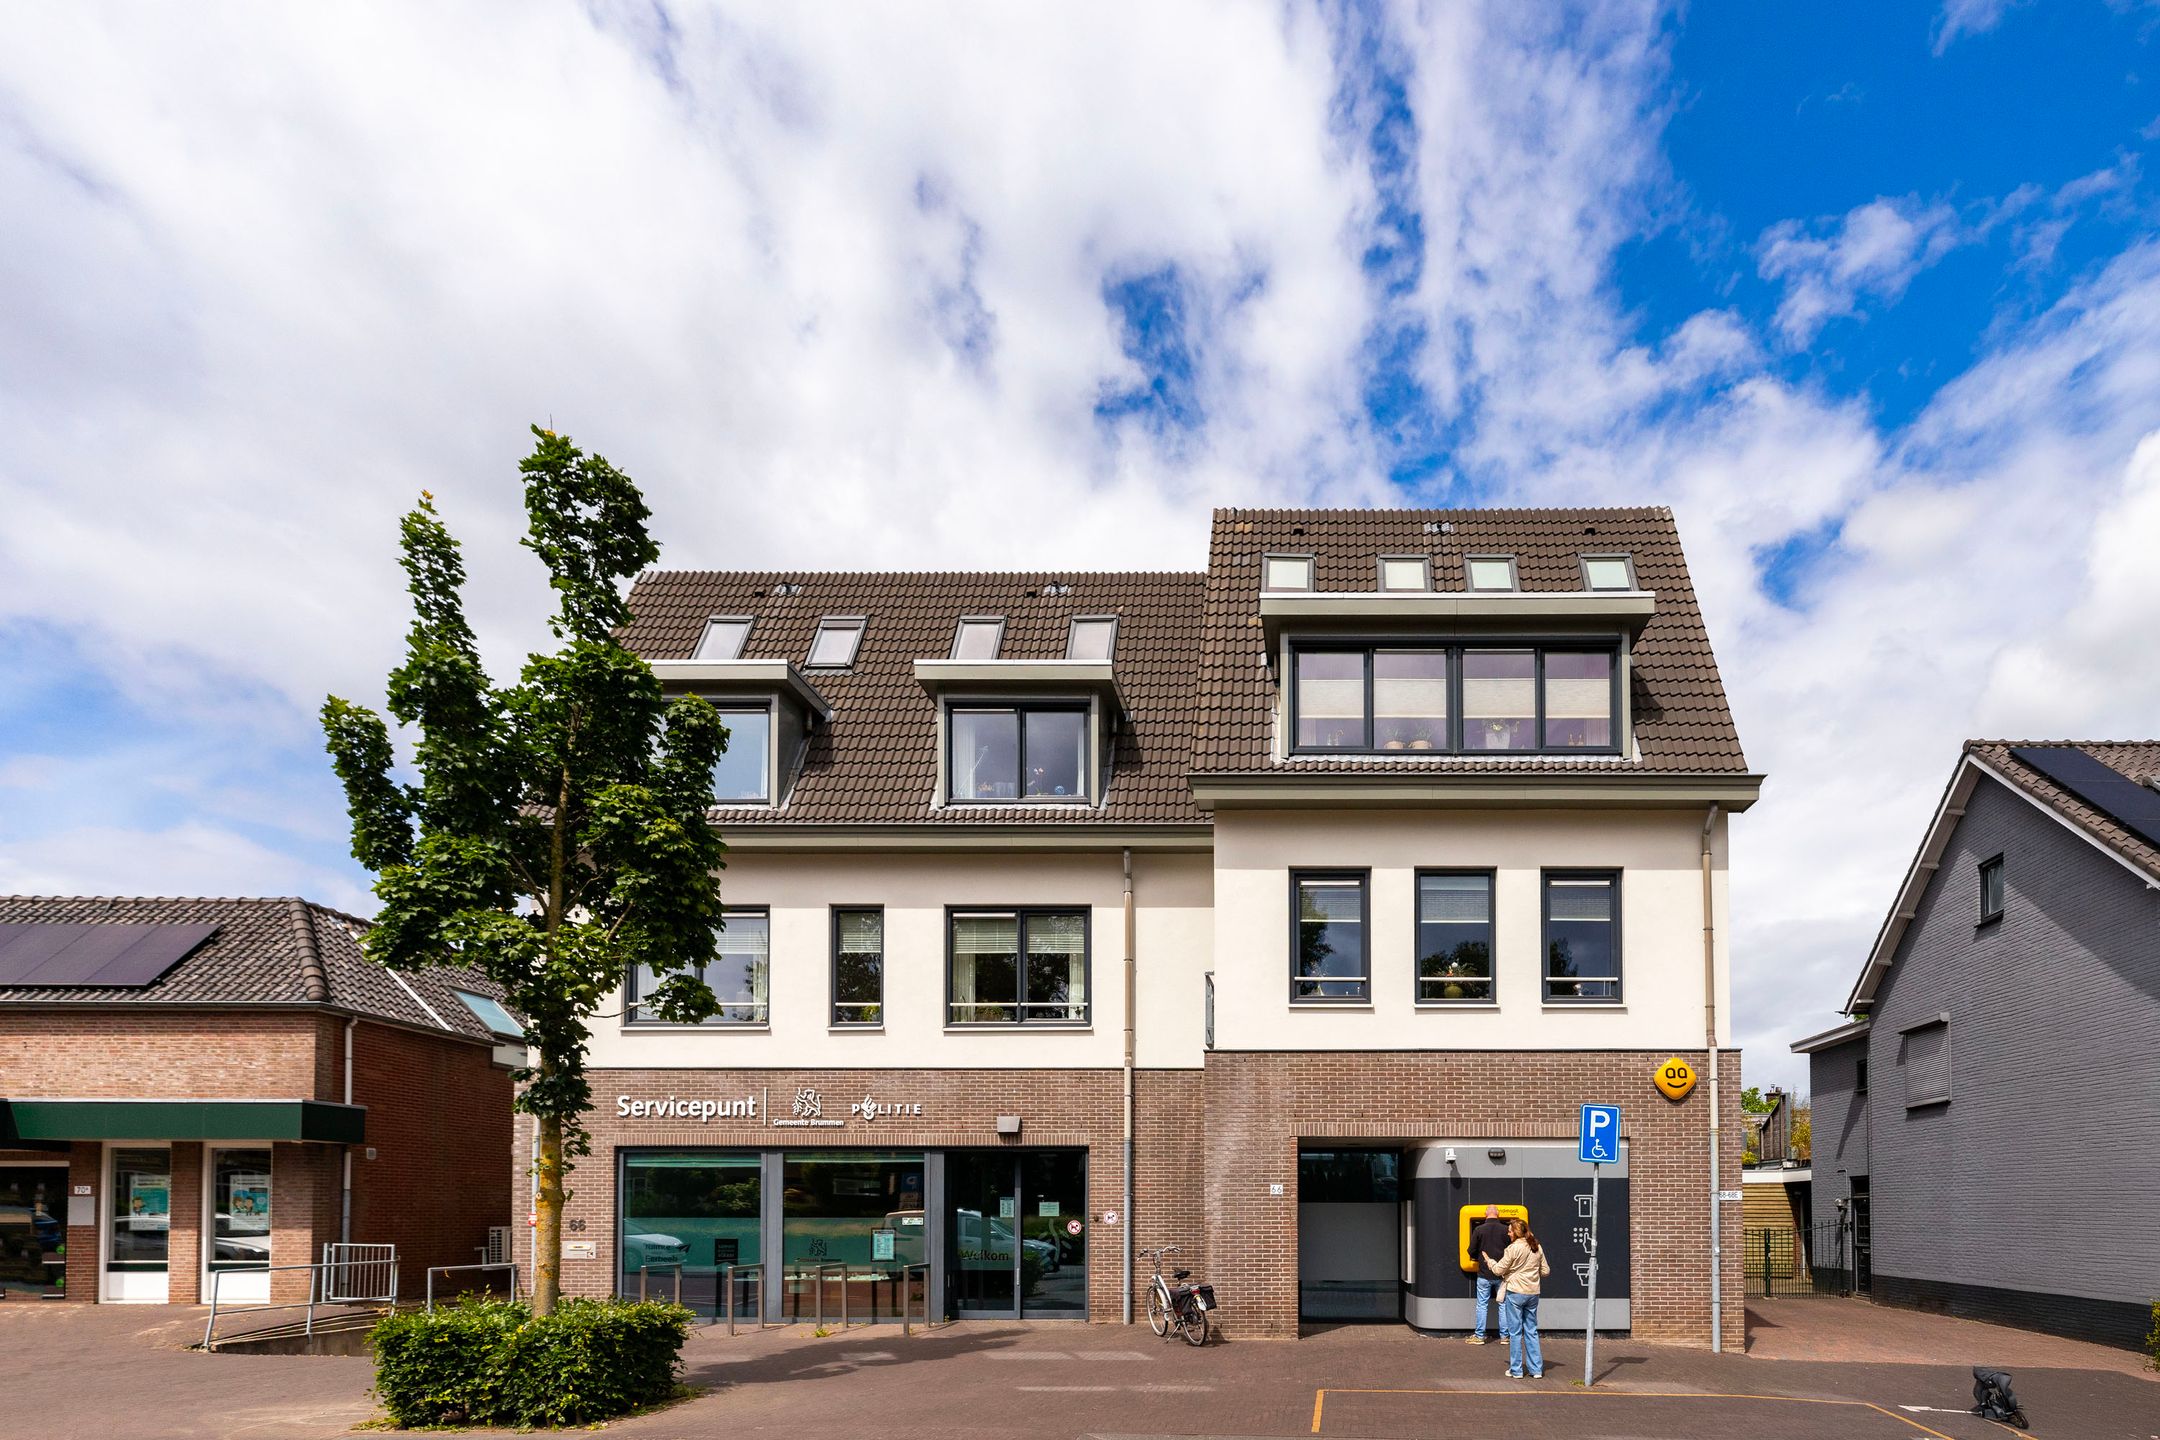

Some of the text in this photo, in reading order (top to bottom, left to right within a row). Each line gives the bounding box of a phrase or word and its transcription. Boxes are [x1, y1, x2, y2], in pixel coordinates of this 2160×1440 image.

[616, 1095, 757, 1123] Servicepunt
[773, 1118, 845, 1127] Gemeente Brummen
[1590, 1110, 1610, 1138] P
[1271, 1185, 1283, 1194] 66
[570, 1219, 587, 1232] 66
[959, 1248, 1009, 1261] Welkom
